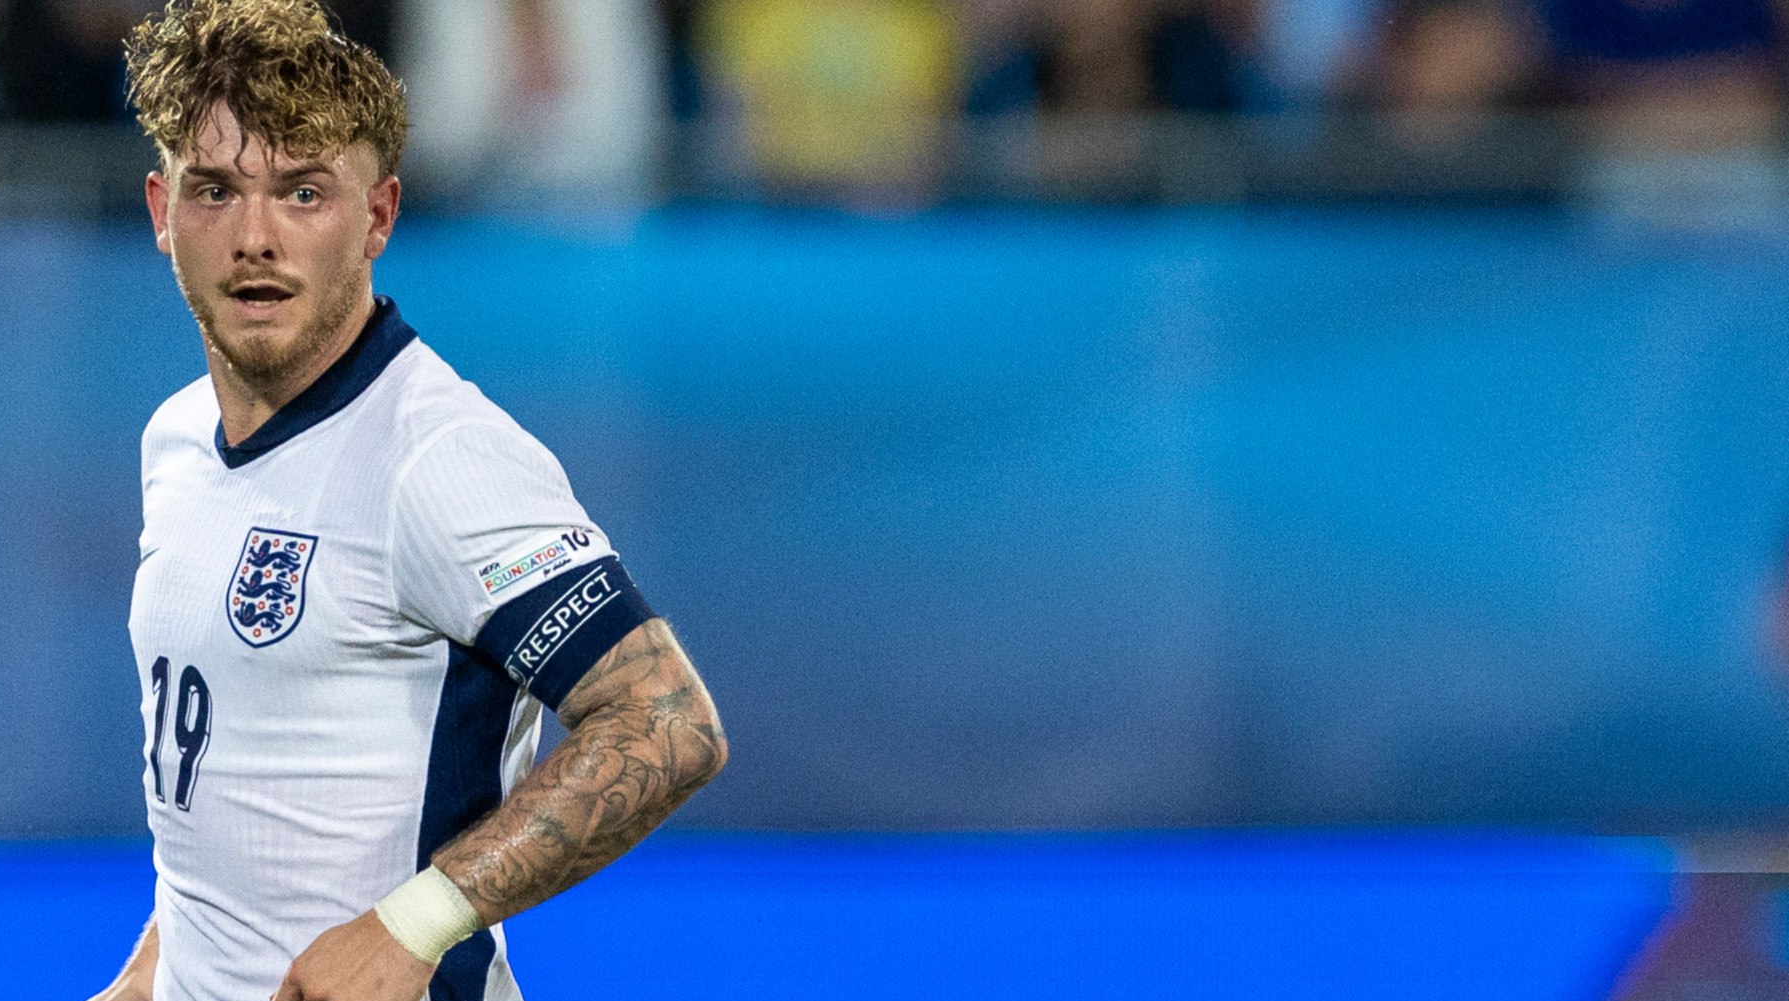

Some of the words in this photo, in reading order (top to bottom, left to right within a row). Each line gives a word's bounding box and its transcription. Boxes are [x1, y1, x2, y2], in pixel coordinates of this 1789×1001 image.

[479, 562, 501, 577] UEFA
[484, 543, 566, 591] FOUNDATION
[518, 572, 611, 668] RESPECT
[150, 655, 212, 813] 19
